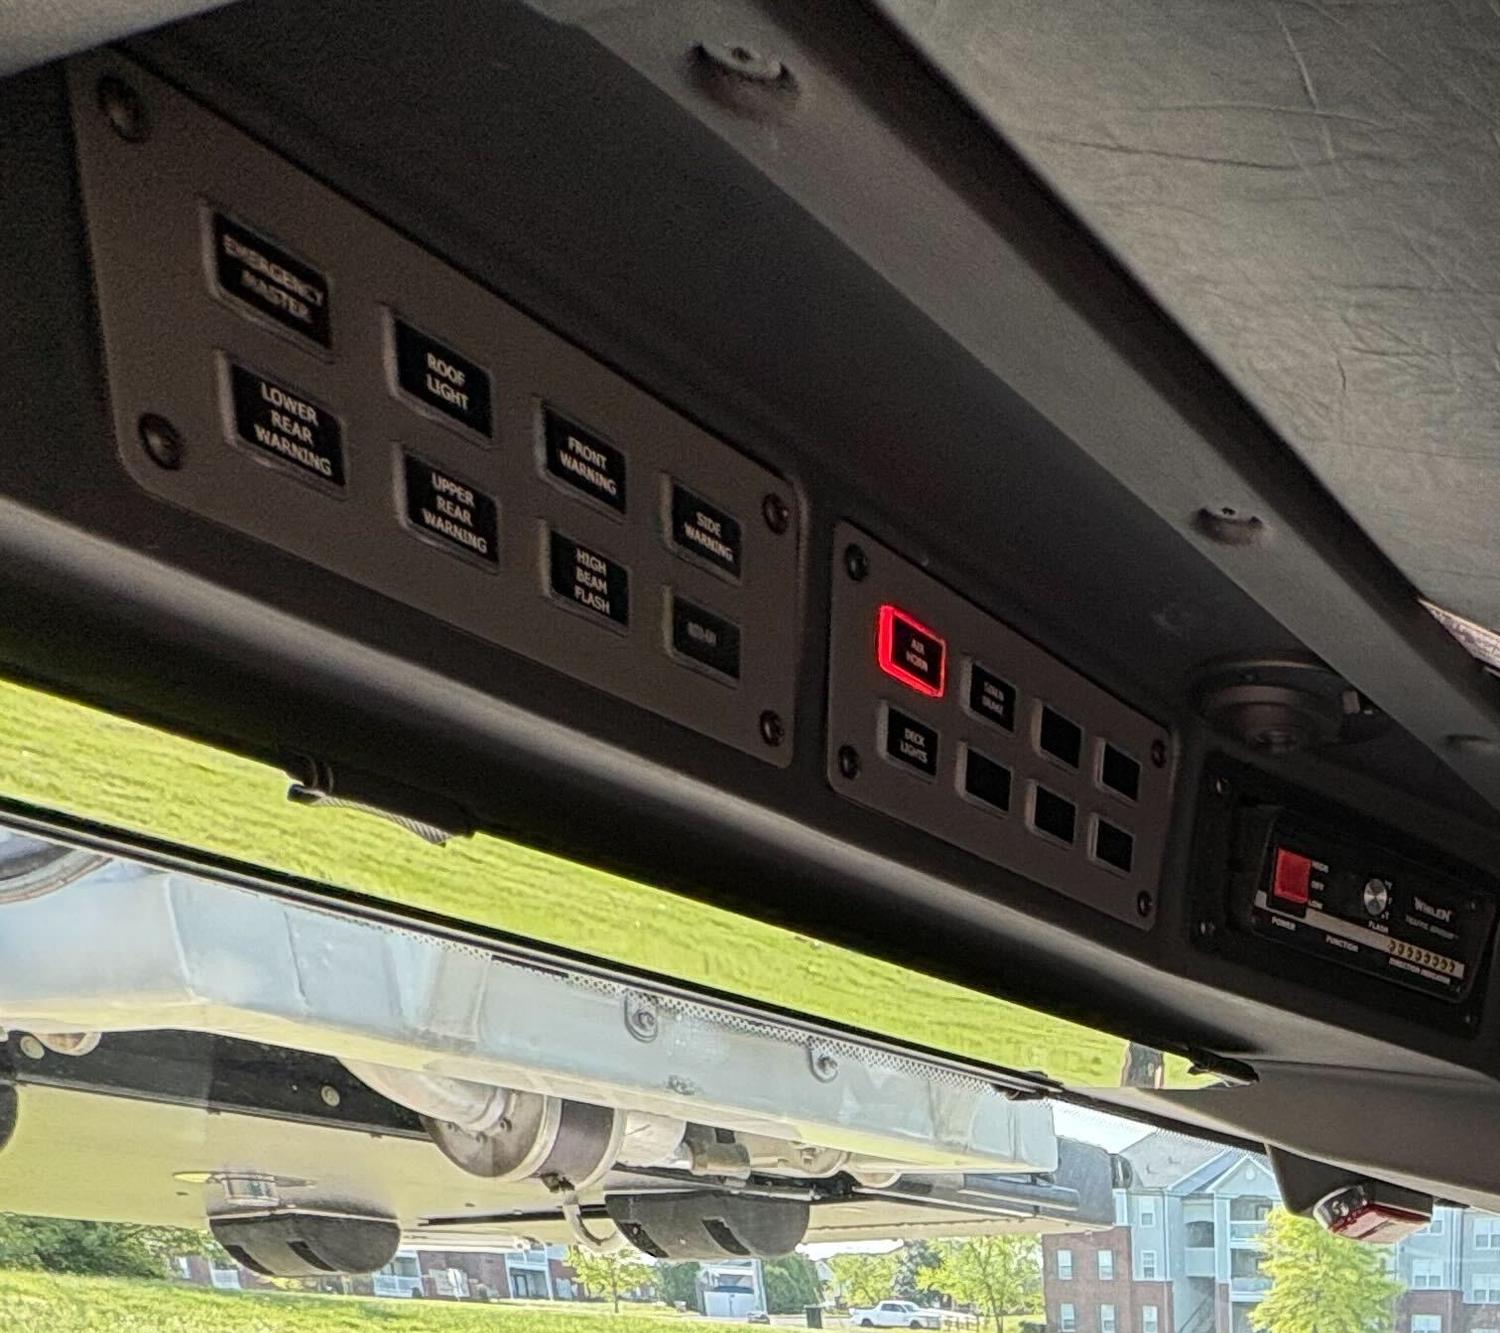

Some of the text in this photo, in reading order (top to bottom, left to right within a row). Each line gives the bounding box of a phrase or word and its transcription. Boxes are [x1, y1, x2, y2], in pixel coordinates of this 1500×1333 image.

[427, 352, 466, 386] ROOF
[261, 382, 319, 427] LOWER
[426, 374, 470, 410] LIGHT
[271, 409, 314, 446] REAR
[254, 423, 332, 476] WARNING
[568, 436, 608, 471] FRONT
[432, 472, 475, 508] UPPER
[560, 449, 617, 496] WARNING
[436, 494, 473, 527] REAR
[696, 511, 722, 537] SIDE
[422, 508, 488, 554] WARNING
[685, 522, 734, 562] WARNING
[576, 547, 607, 577] HIGH
[576, 565, 608, 595] BEAM
[574, 585, 610, 615] FLASH
